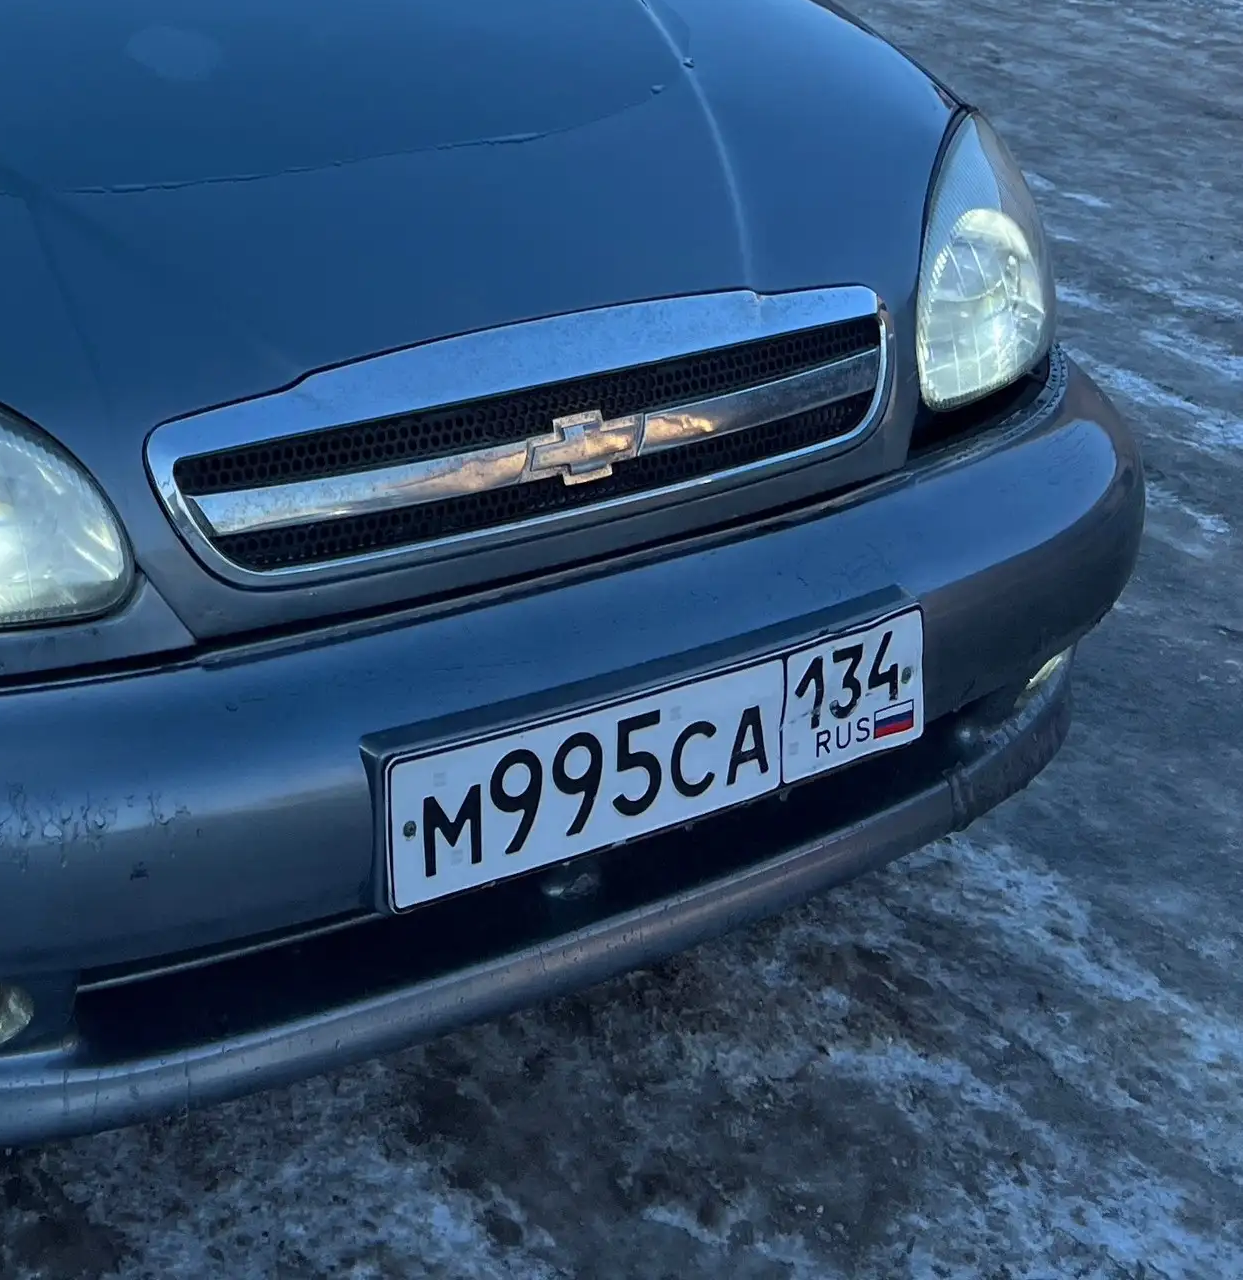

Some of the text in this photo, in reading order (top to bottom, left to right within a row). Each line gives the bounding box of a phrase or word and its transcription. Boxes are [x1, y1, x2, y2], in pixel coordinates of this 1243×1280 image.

[422, 630, 899, 878] М995СА 134
[815, 717, 871, 757] RUS
